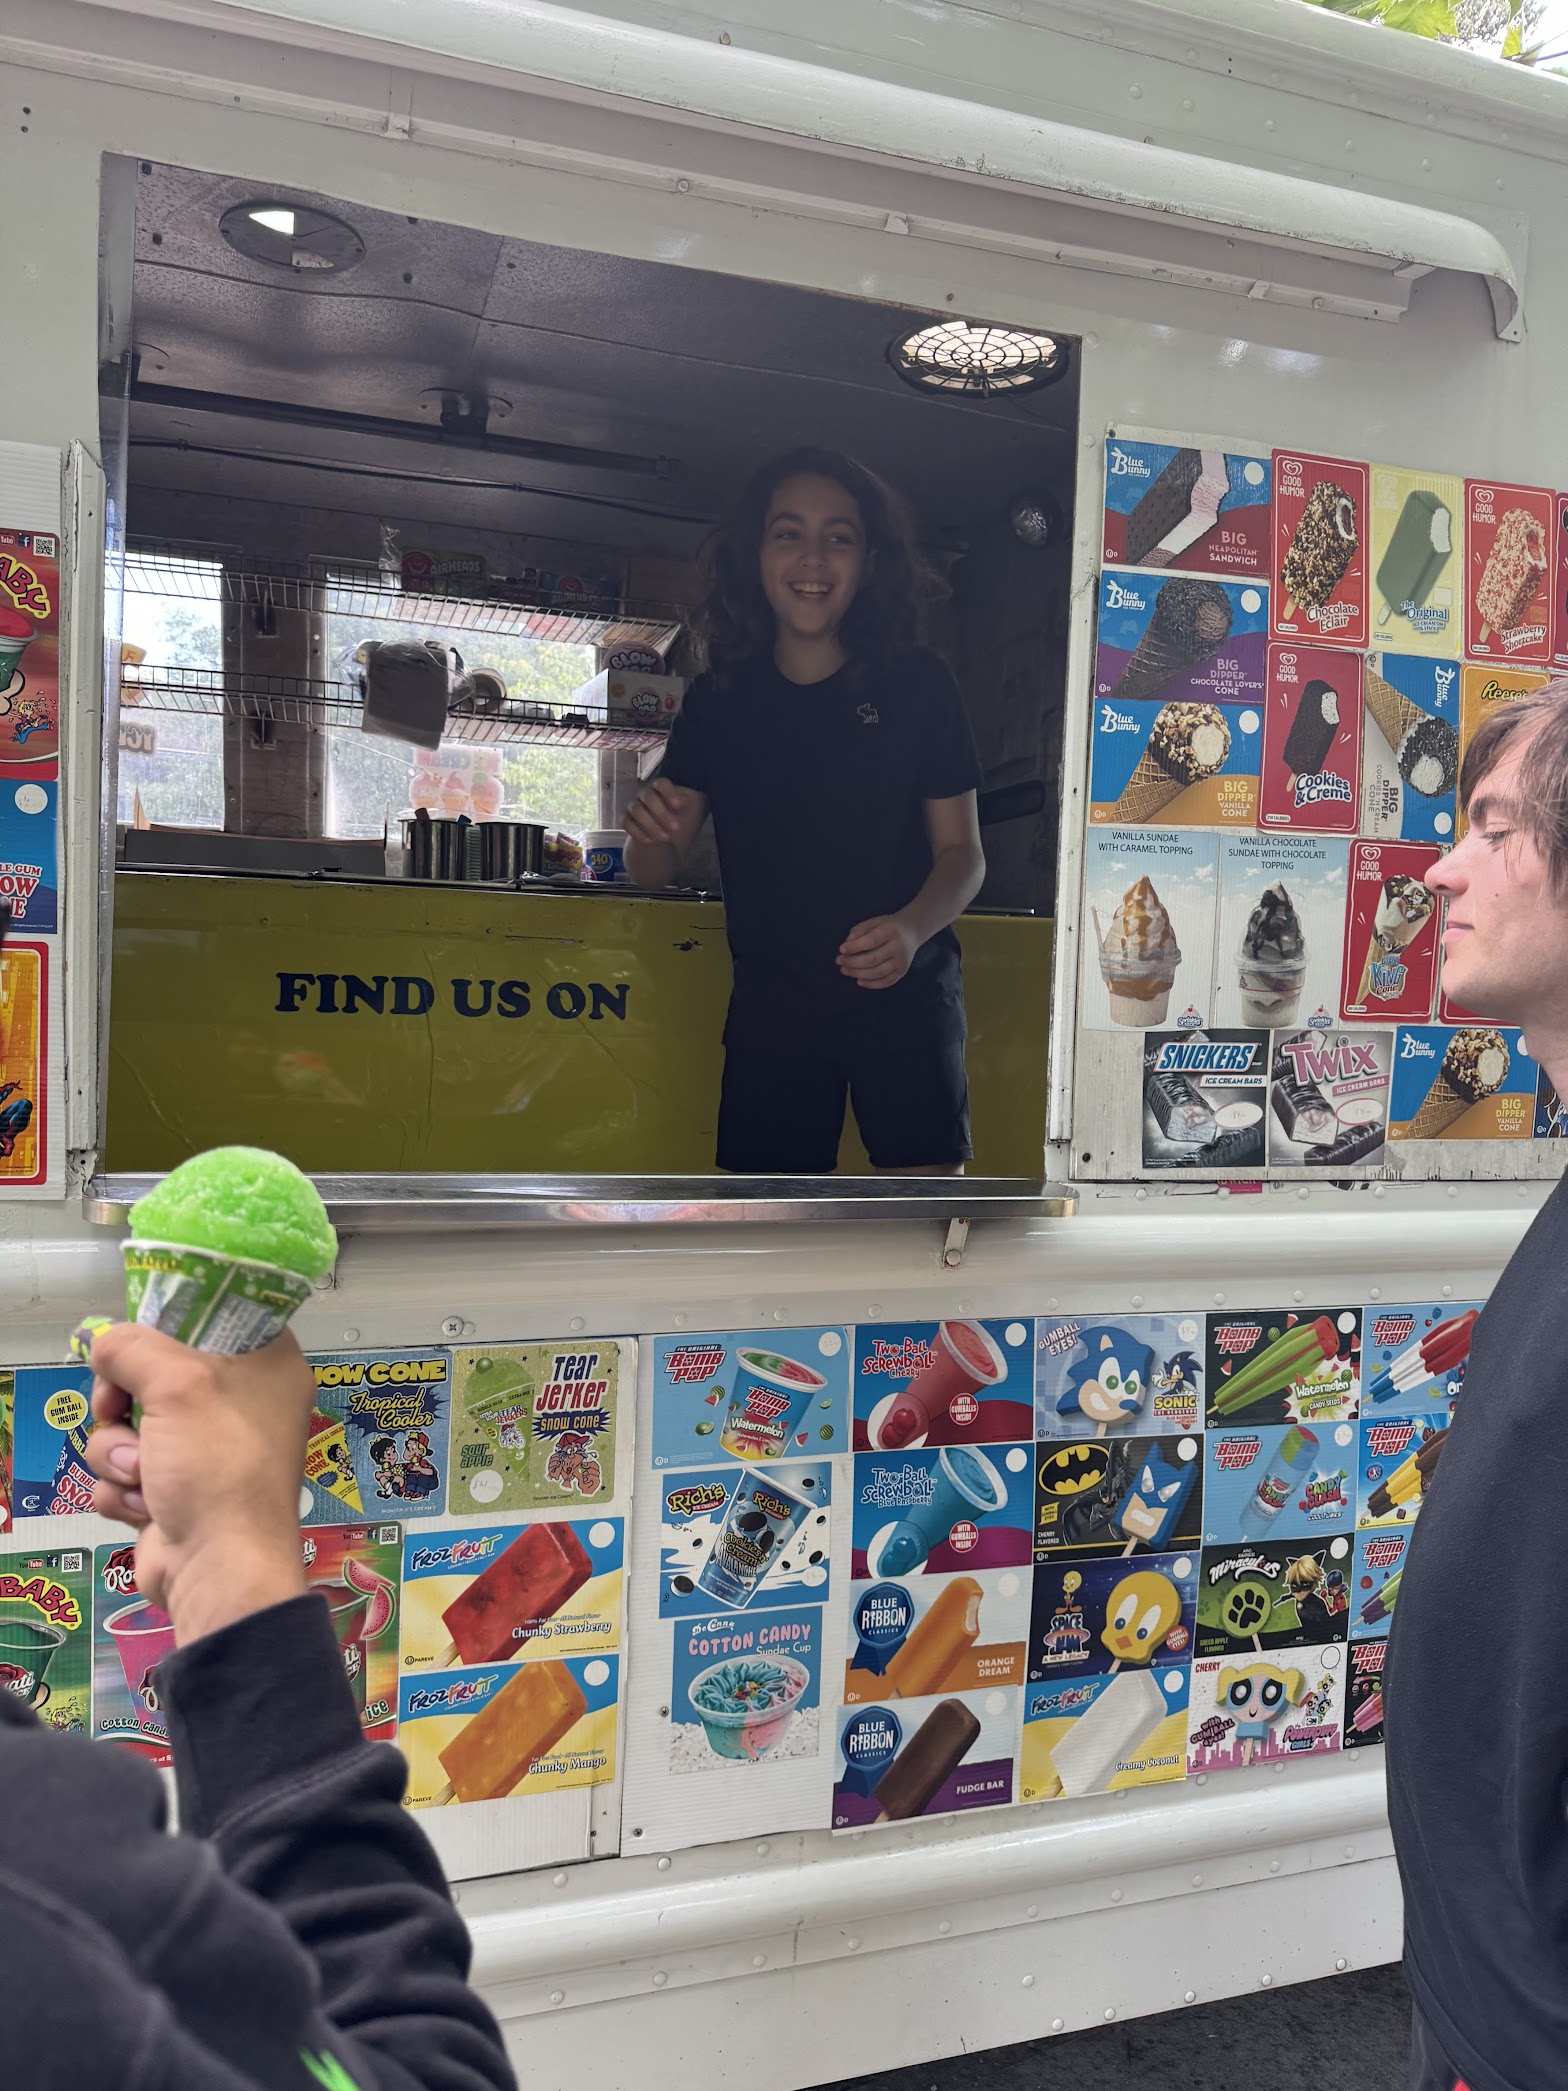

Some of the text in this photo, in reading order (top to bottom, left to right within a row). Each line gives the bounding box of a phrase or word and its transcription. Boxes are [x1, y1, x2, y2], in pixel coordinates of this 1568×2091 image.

[1283, 476, 1301, 486] GOOD
[1280, 485, 1305, 497] HUMOR
[1475, 503, 1493, 513] GOOD
[1473, 513, 1496, 524] HUMOR
[1222, 531, 1246, 545] BIG
[1209, 544, 1257, 556] NEAPOLITAN
[1210, 553, 1257, 566] SANDWICH
[431, 560, 480, 575] AIRHEADS
[1308, 602, 1357, 621] Chocolate
[1407, 606, 1447, 619] Original
[1321, 617, 1348, 632] Eclair
[1501, 624, 1545, 642] Strawberry
[1506, 634, 1542, 652] Shortcake
[611, 651, 657, 669] BLOW
[1217, 659, 1238, 670] BIG
[1211, 670, 1245, 679] DIPPER
[1279, 665, 1295, 674] GOOD
[1191, 679, 1232, 688] CHOCOLATE
[1277, 673, 1298, 683] HUMOR
[1215, 687, 1239, 695] CONE
[1224, 781, 1248, 792] BIG
[1296, 772, 1349, 790] Cookies
[1218, 792, 1254, 801] DIPPER
[1307, 786, 1351, 801] Creme
[1381, 780, 1389, 819] DIPPER
[1389, 788, 1398, 813] BIG
[1222, 808, 1247, 816] CONE
[1112, 832, 1178, 842] VANILLA SUNDAE
[1240, 838, 1316, 847] VANILLA CHOCOLATE
[1099, 843, 1193, 855] WITH CARAMEL TOPPING
[1229, 849, 1326, 859] SUNDAE WITH CHOCOLATE
[15, 865, 41, 875] GUM
[1261, 861, 1294, 869] TOPPING
[1361, 862, 1379, 871] GOOD
[1357, 870, 1382, 881] HUMOR
[1372, 963, 1404, 989] KING
[275, 973, 630, 1020] FIND US ON
[1158, 1044, 1253, 1070] SNICKERS
[1336, 1078, 1385, 1094] ICE CREAM BARS
[1502, 1099, 1521, 1110] BIG
[1496, 1109, 1525, 1117] DIPPER
[1499, 1123, 1520, 1131] CONE
[1214, 1327, 1262, 1340] BOMB
[1371, 1320, 1416, 1333] BOMB
[1038, 1322, 1082, 1350] GUMBALL
[1372, 1333, 1409, 1346] POP
[1049, 1334, 1079, 1356] EYES!
[1217, 1340, 1255, 1354] POP
[665, 1351, 726, 1367] BOMB
[369, 1360, 446, 1382] CONE
[554, 1355, 597, 1382] Tear
[666, 1366, 716, 1383] POP
[1295, 1379, 1349, 1399] Watermelon
[57, 1395, 72, 1405] FREE
[350, 1387, 426, 1416] Tropical
[536, 1382, 607, 1411] Jerker
[1154, 1395, 1197, 1409] SONIC
[50, 1403, 82, 1417] GUM BALL
[951, 1404, 977, 1414] GUMBALLS
[1310, 1402, 1325, 1410] CANDY
[58, 1413, 79, 1424] INSIDE
[380, 1408, 433, 1428] Cooler
[540, 1415, 599, 1431] snow cone
[956, 1413, 972, 1421] INSIDE
[731, 1418, 784, 1439] Watermelon
[1367, 1426, 1416, 1440] BOMB
[461, 1444, 490, 1457] sour
[1213, 1442, 1262, 1455] BOMB
[1368, 1440, 1407, 1457] POP
[460, 1454, 493, 1468] apple
[1215, 1455, 1254, 1470] POP
[69, 1464, 98, 1489] BUBBL
[1306, 1476, 1342, 1498] CANDY
[670, 1485, 725, 1515] Rich's
[753, 1492, 791, 1515] Rich's
[1307, 1488, 1341, 1509] CLASH
[957, 1524, 970, 1532] WITH
[951, 1532, 977, 1541] GUMBALLS
[956, 1540, 972, 1549] INSIDE
[1363, 1541, 1406, 1555] BOMB
[716, 1544, 757, 1577] AVALANCHE
[726, 1543, 758, 1567] Cream
[1364, 1554, 1398, 1568] POP
[1210, 1555, 1281, 1584] Miraculous
[871, 1598, 897, 1609] BLUE
[862, 1607, 906, 1630] RIBBON
[512, 1621, 611, 1639] Chunky Strawberry
[868, 1627, 898, 1635] CLASSICS
[689, 1624, 811, 1656] COTTON CANDY
[757, 1642, 811, 1656] Sundae Cup
[977, 1657, 1015, 1667] ORANGE
[1196, 1662, 1221, 1673] CHERRY
[979, 1666, 1010, 1677] DREAM
[365, 1700, 389, 1722] ice
[101, 1718, 140, 1730] Cotton
[859, 1721, 885, 1732] BLUE
[1283, 1723, 1338, 1743] POWERPUFF
[850, 1731, 894, 1754] RIBBON
[1291, 1740, 1311, 1750] GIRLS
[856, 1750, 886, 1759] CLASSICS
[528, 1756, 606, 1774] Chunky Mango
[1115, 1755, 1179, 1772] Creamy Coconut
[957, 1780, 1004, 1794] FUDGE BAR
